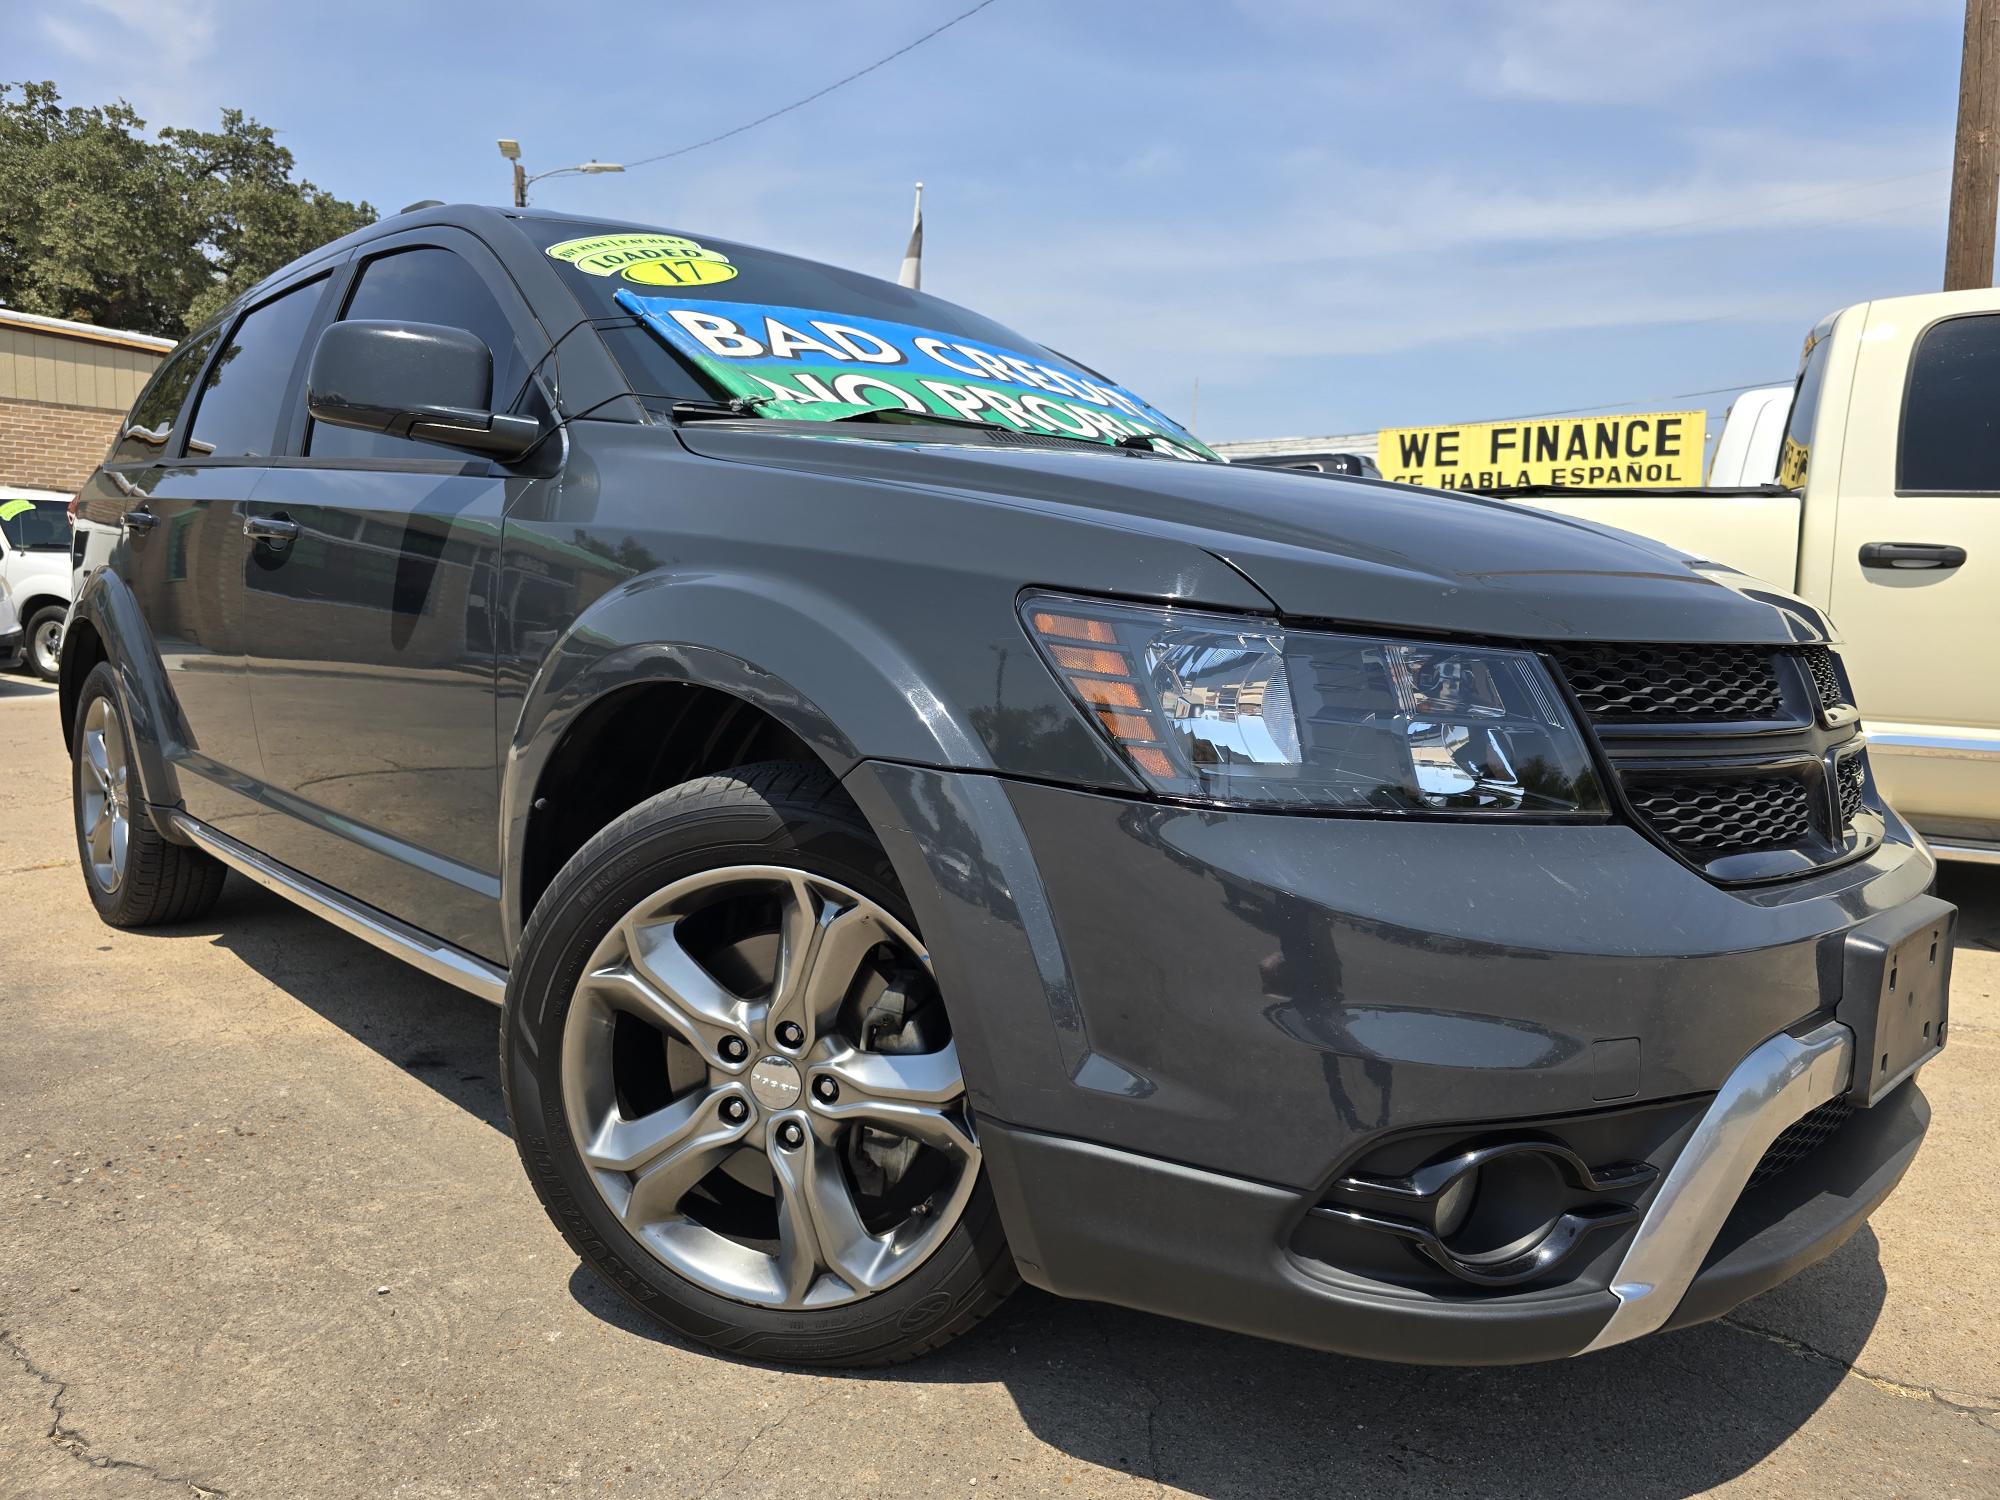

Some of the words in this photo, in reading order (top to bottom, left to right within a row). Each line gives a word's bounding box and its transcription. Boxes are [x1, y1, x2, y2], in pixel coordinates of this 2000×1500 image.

[588, 249, 703, 269] LOADED
[659, 260, 703, 283] 17
[667, 309, 906, 364] BAD
[745, 372, 932, 413] NO
[1399, 431, 1461, 469] WE
[1490, 418, 1682, 465] FINANCE
[1440, 470, 1532, 489] HABLA
[1551, 462, 1682, 486] ESPAÑOL
